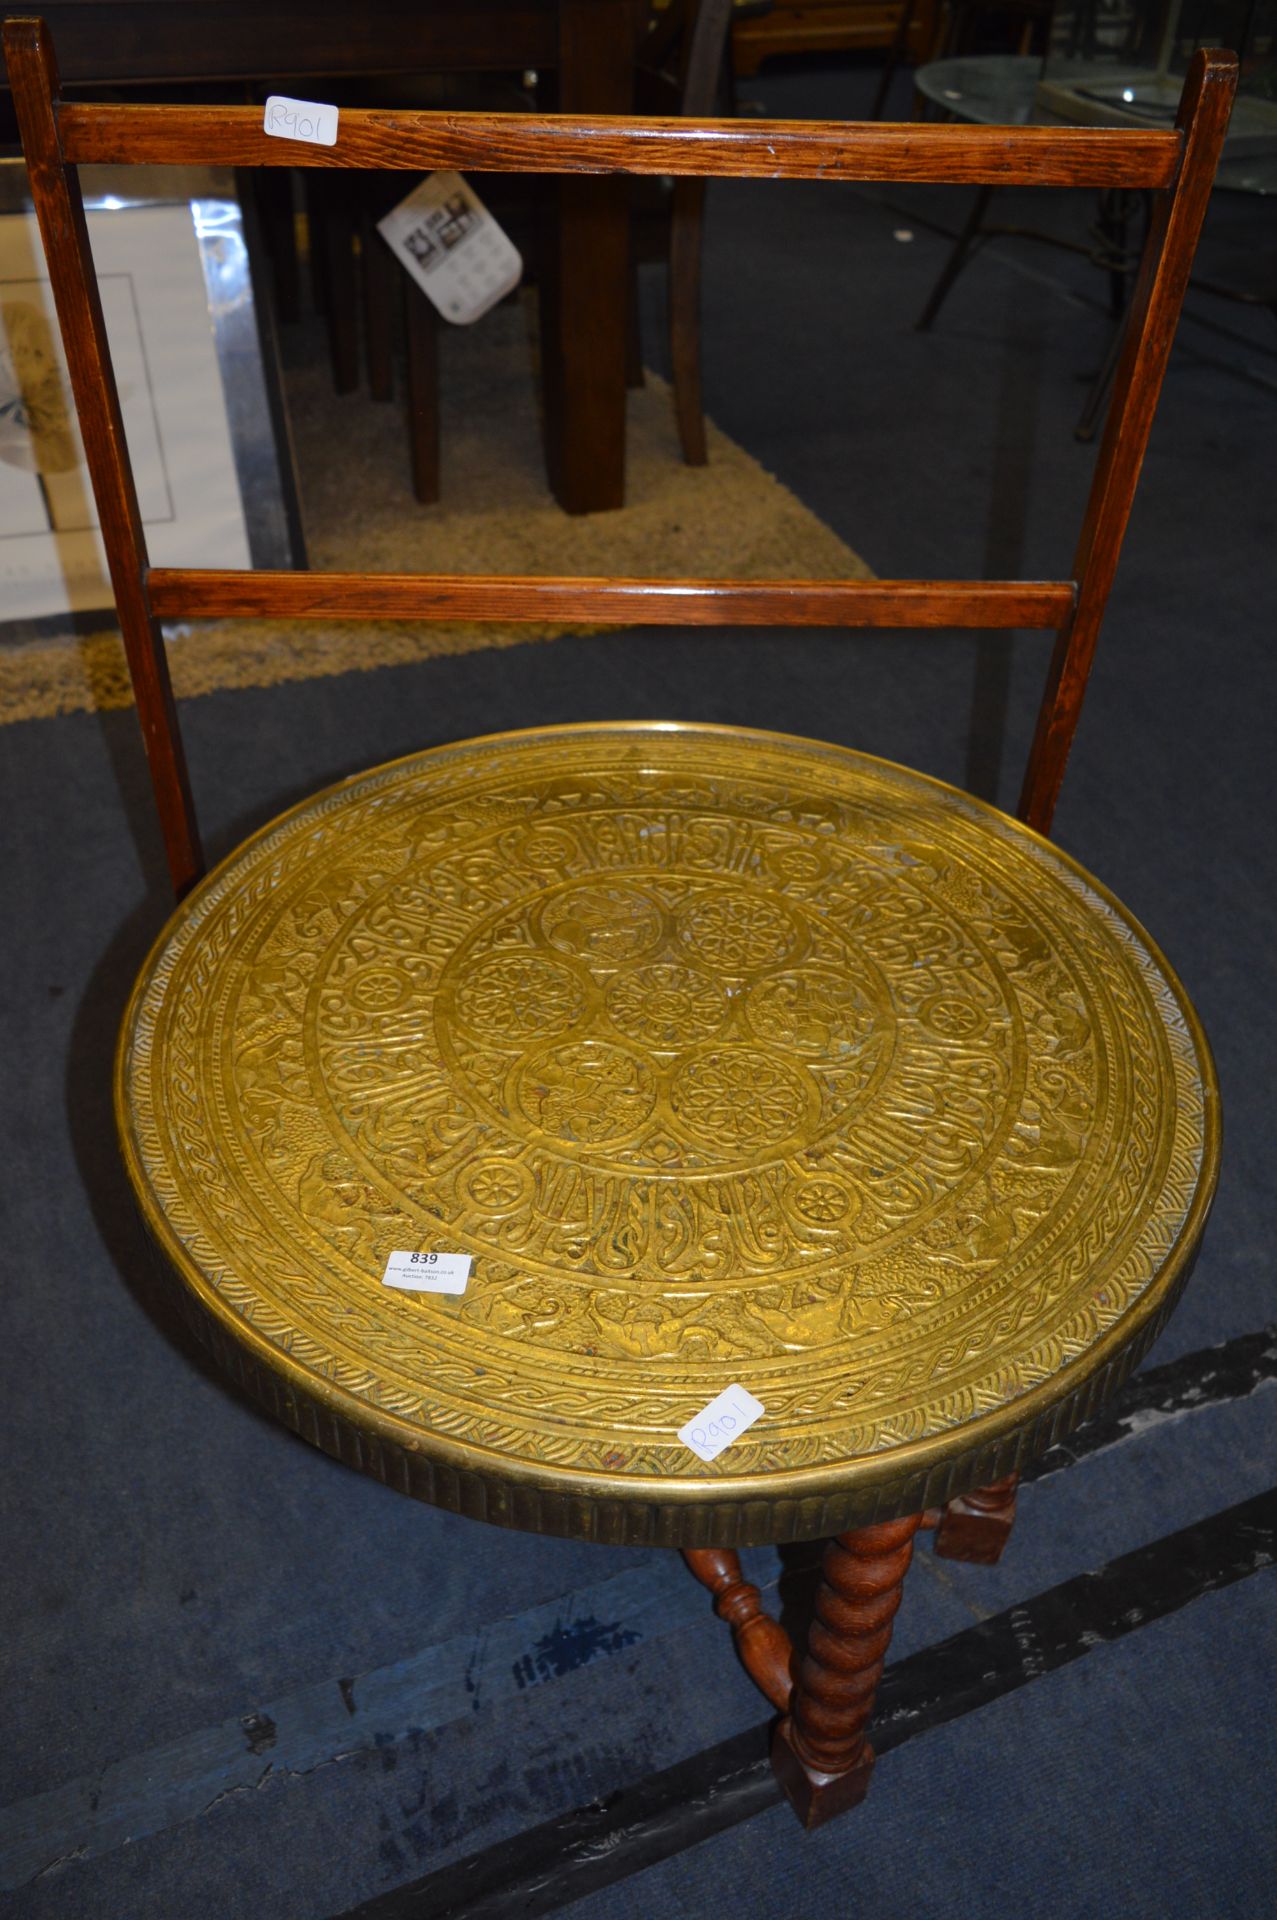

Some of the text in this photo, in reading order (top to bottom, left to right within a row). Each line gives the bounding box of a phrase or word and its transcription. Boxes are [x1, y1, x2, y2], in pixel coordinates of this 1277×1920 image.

[268, 104, 321, 140] R901
[410, 1253, 438, 1265] 839
[691, 1402, 748, 1455] R901
